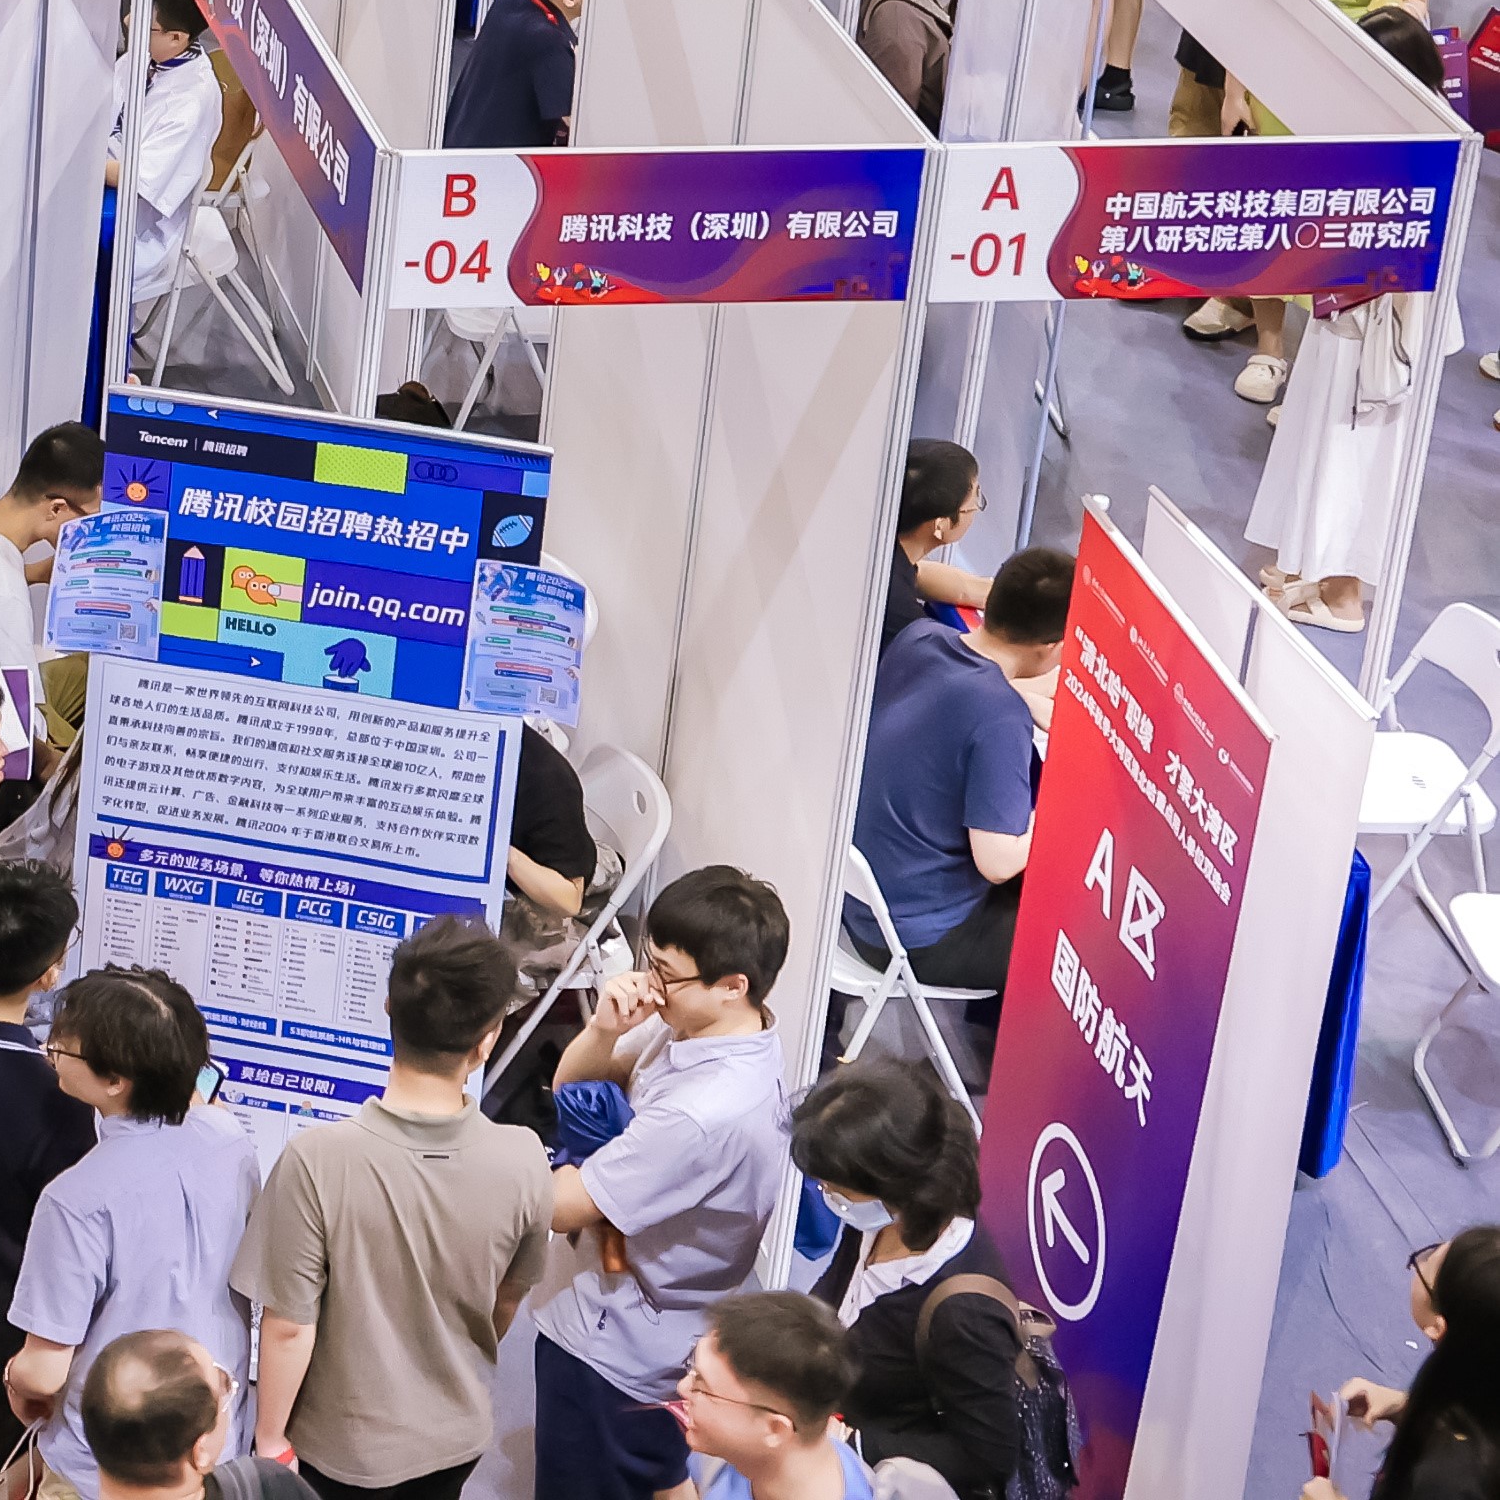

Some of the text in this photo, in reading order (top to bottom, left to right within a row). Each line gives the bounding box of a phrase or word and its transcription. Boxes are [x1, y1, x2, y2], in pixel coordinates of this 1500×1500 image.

[444, 174, 476, 217] B
[983, 167, 1018, 211] A
[1105, 187, 1435, 218] 中国航天科技集团有限公司
[559, 209, 898, 244] 腾讯科技（深圳）有限公司
[406, 239, 491, 285] -04
[952, 232, 1025, 277] -01
[138, 430, 247, 457] Tencent 腾讯招聘
[179, 487, 469, 556] 腾讯校园招聘热招中
[225, 616, 276, 636] HELLO
[307, 581, 464, 626] join.qq.com
[1074, 625, 1237, 868] “清北哈”职缘 才聚大湾区
[112, 870, 396, 930] TEG WXG IEG PCG CSIG
[1084, 827, 1166, 981] A区
[1050, 929, 1154, 1128] 国防航天
